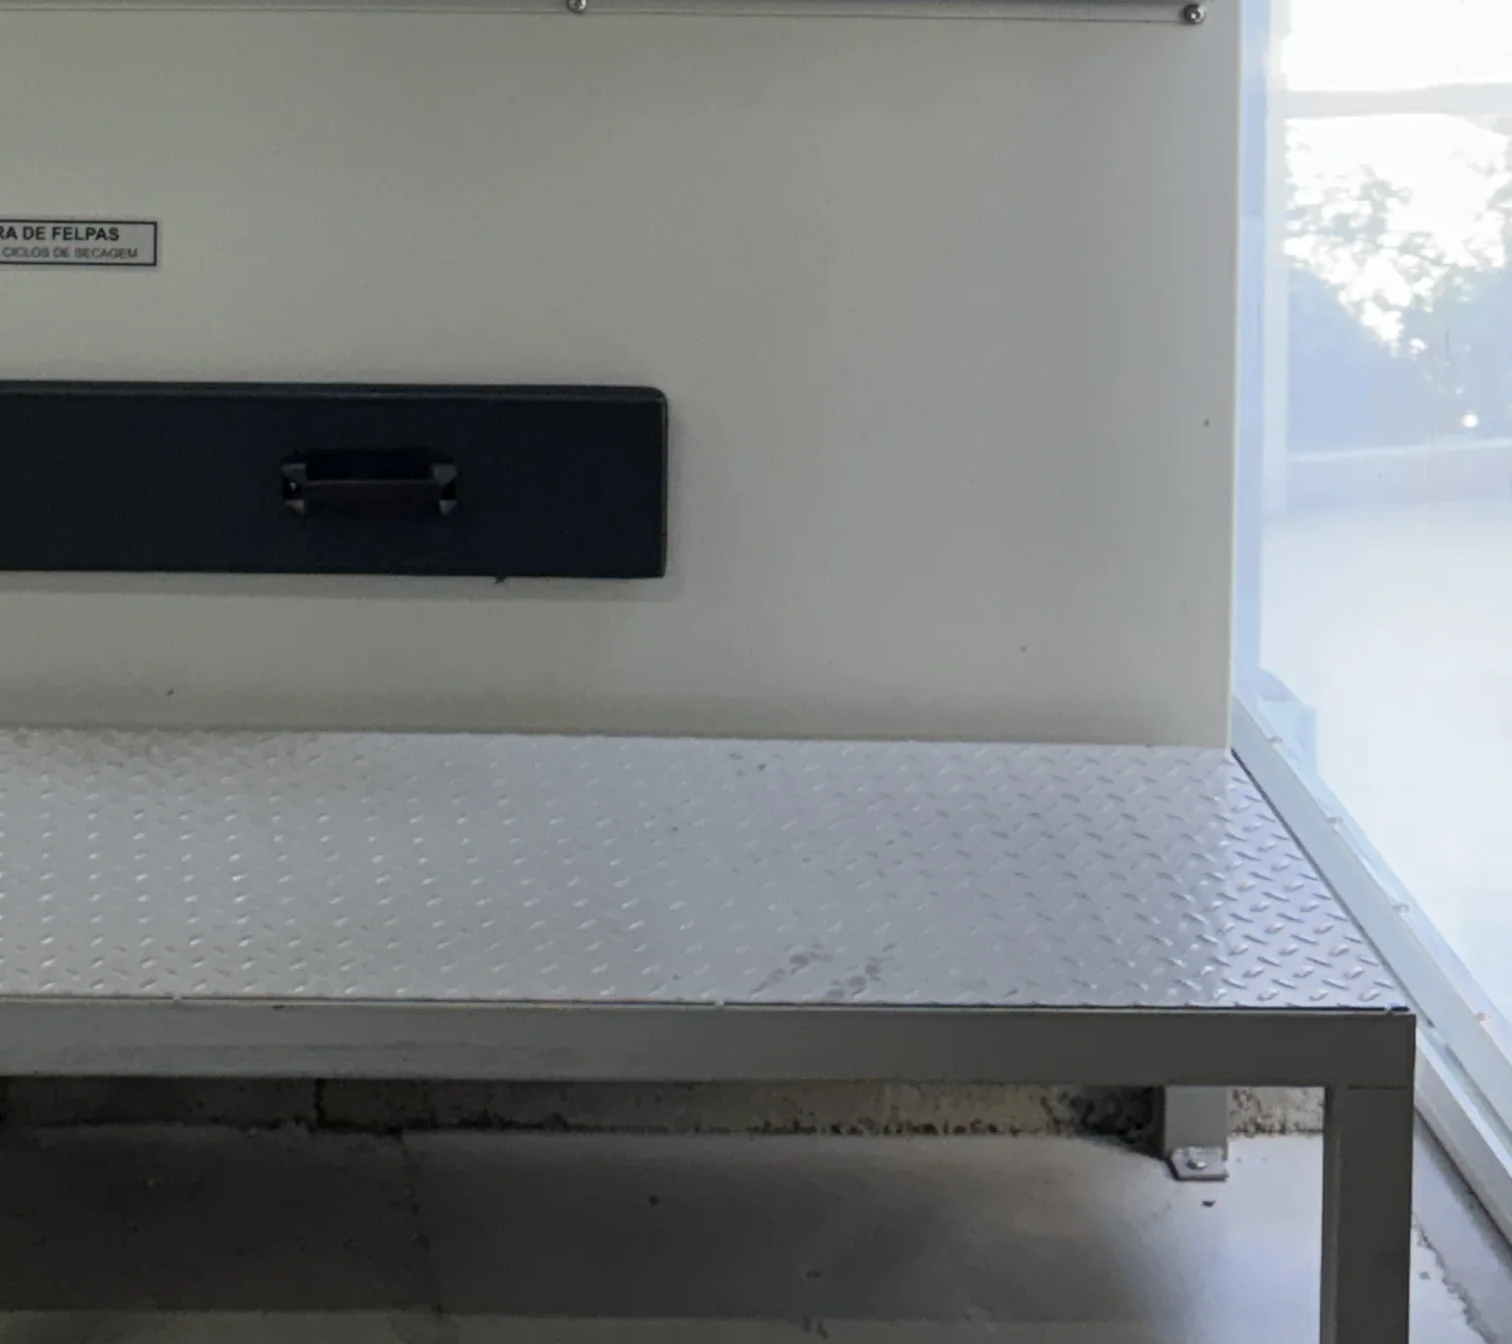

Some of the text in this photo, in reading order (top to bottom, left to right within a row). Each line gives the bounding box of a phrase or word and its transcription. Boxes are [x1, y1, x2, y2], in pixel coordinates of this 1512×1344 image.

[22, 226, 46, 241] DE
[51, 226, 120, 242] FELPAS
[2, 246, 51, 258] CICLOS
[52, 247, 70, 258] DE
[74, 247, 140, 259] SECAGEM
